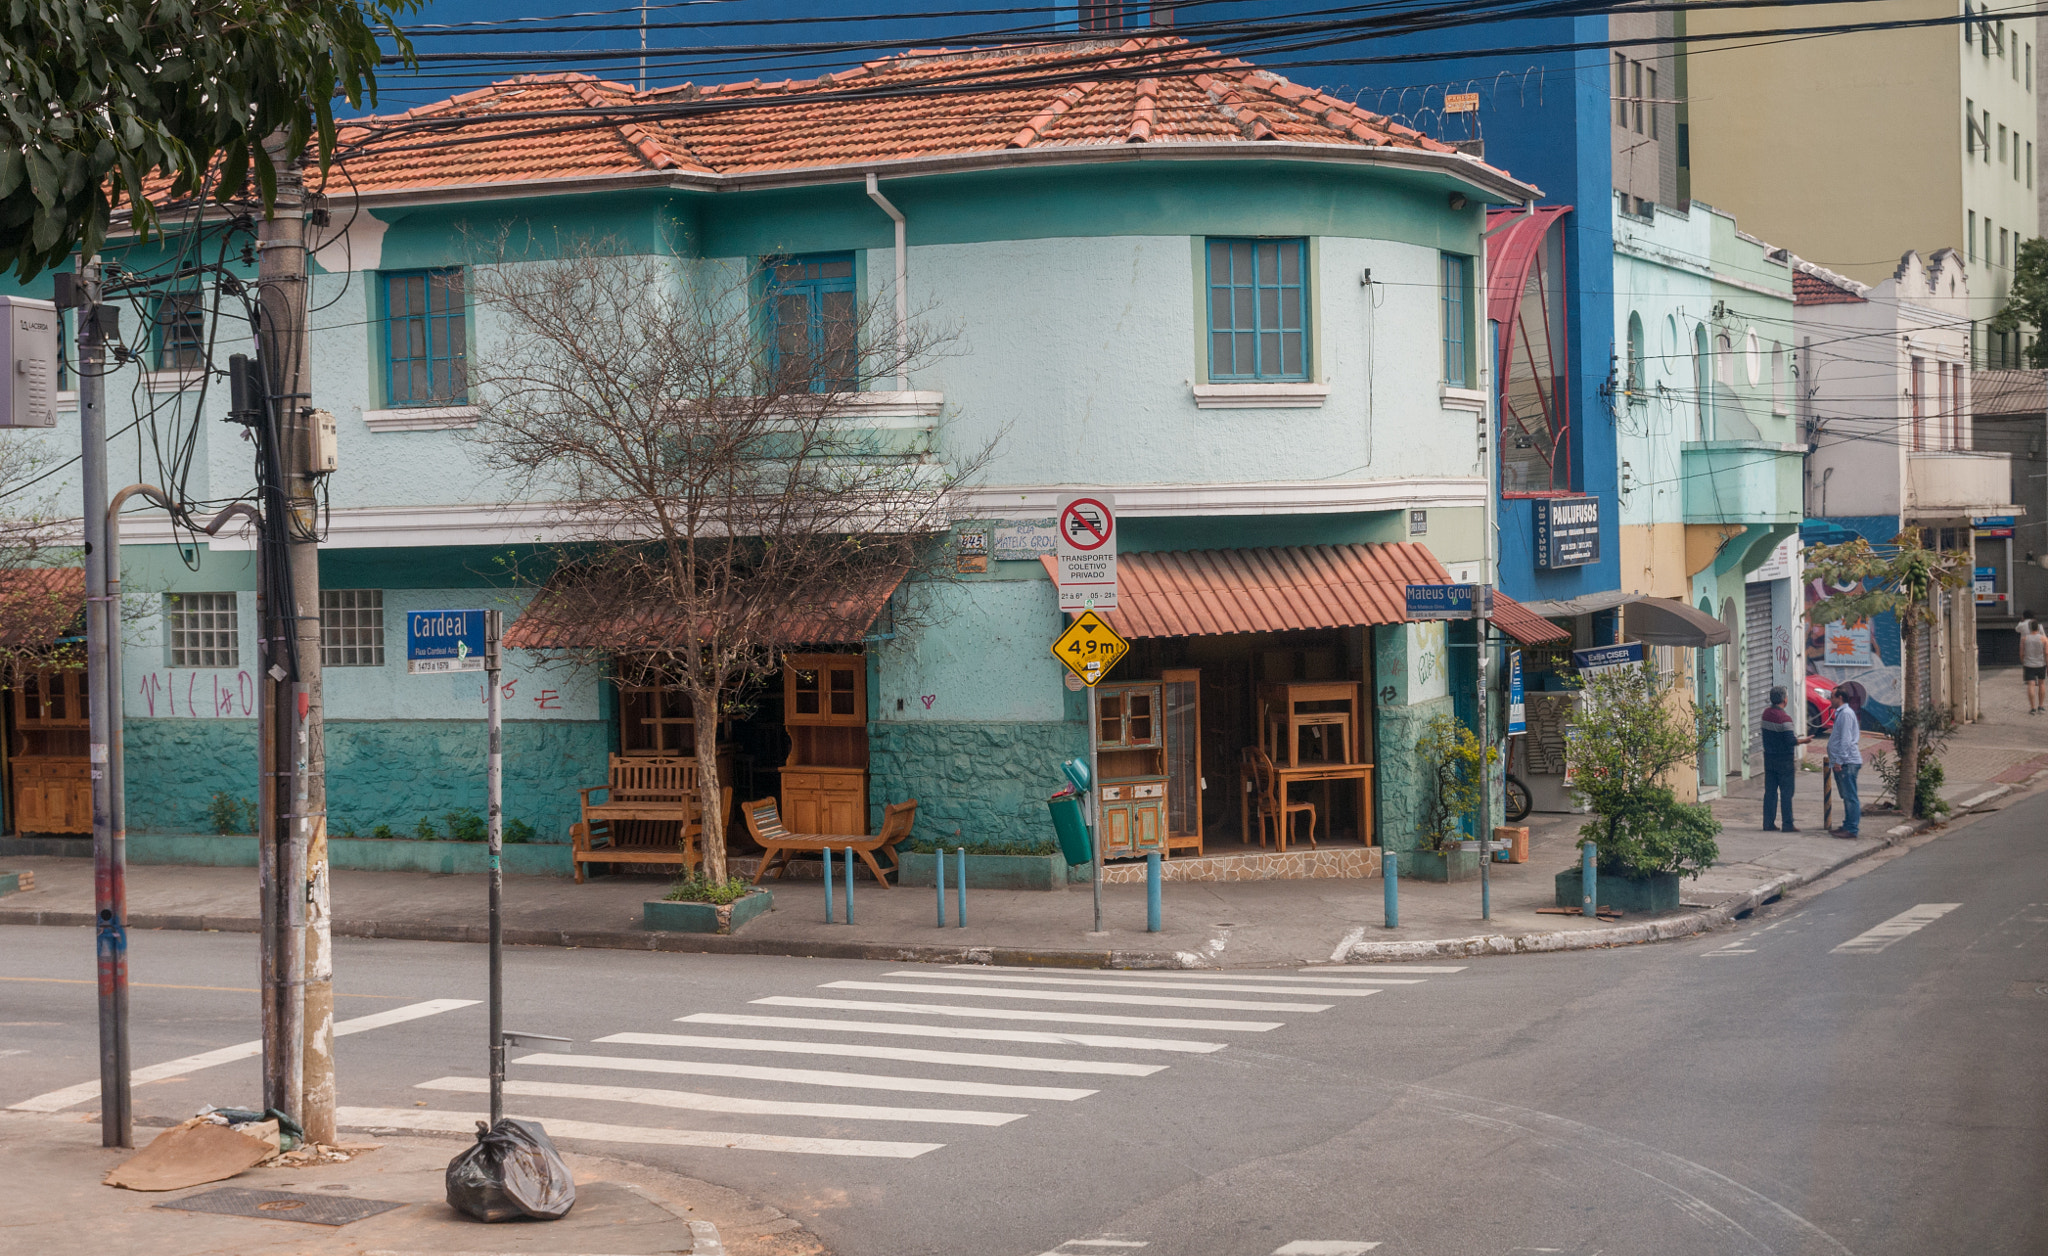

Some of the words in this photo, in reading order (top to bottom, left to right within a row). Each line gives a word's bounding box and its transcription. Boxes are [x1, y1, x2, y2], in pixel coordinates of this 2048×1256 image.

[28, 323, 48, 331] LACERDA
[1553, 504, 1597, 525] PAULUFUSOS
[1017, 526, 1035, 534] RUA
[961, 535, 982, 547] 645
[1538, 505, 1547, 567] 3816-2520
[1061, 554, 1114, 562] TRANSPORTE
[1068, 562, 1107, 571] COLETIVO
[1070, 571, 1105, 579] PRIVADO
[1407, 587, 1444, 600] Mateus
[1447, 586, 1471, 600] Grou
[414, 612, 467, 638] Cardeal
[415, 648, 426, 656] Rua
[427, 646, 446, 655] Cardeal
[1606, 649, 1629, 659] CISER
